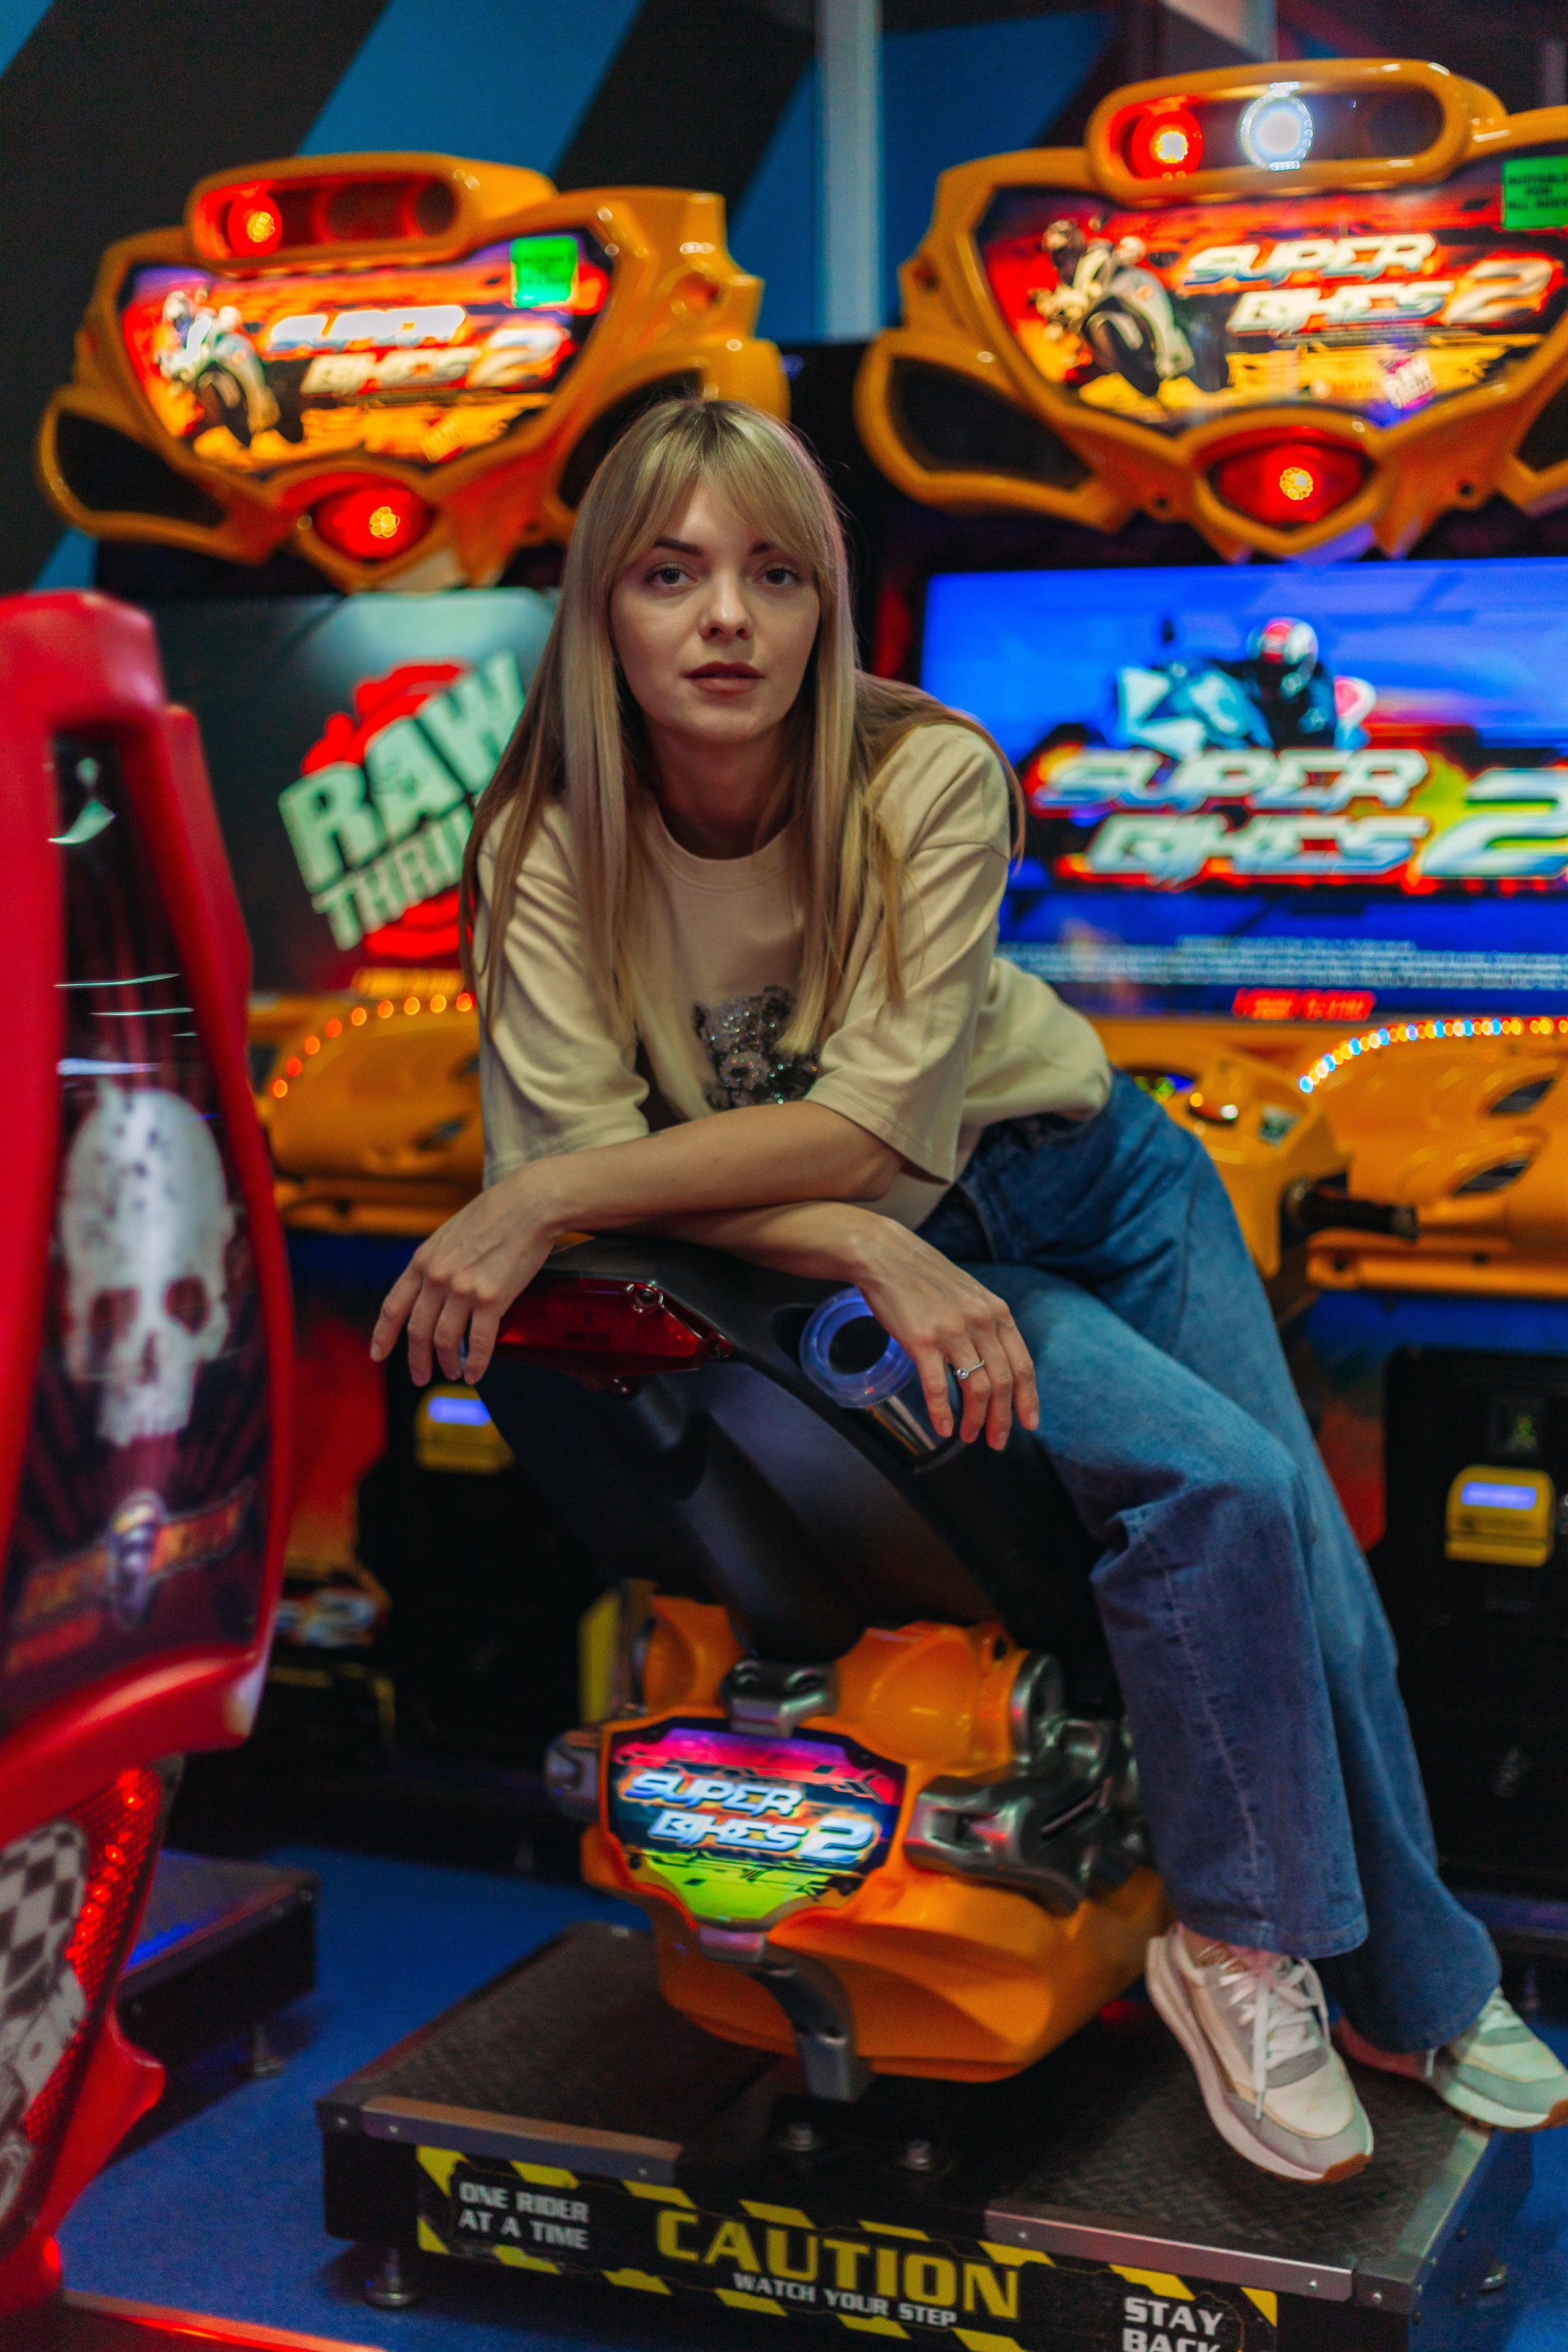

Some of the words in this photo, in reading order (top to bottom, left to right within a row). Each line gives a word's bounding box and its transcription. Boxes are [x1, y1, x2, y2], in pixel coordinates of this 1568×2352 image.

[1184, 233, 1437, 286] SUPER
[1227, 280, 1455, 336] BIKES
[1440, 258, 1555, 325] 2
[277, 648, 526, 894] RAW
[1034, 748, 1429, 812] SUPER
[1084, 813, 1433, 886] BIKES
[1419, 767, 1568, 877] 2
[625, 1772, 804, 1817] SUPER
[648, 1809, 809, 1852] BIKES
[796, 1815, 876, 1864] 2
[458, 2207, 494, 2234] AT
[500, 2215, 522, 2239] A
[529, 2219, 589, 2251] TIME
[459, 2180, 510, 2211] ONE
[515, 2191, 590, 2224] RIDER
[657, 2209, 1019, 2320] CAUTION
[733, 2272, 816, 2303] WATCH
[823, 2288, 889, 2318] YOUR
[897, 2302, 958, 2328] STEP
[1124, 2296, 1224, 2337] STAY
